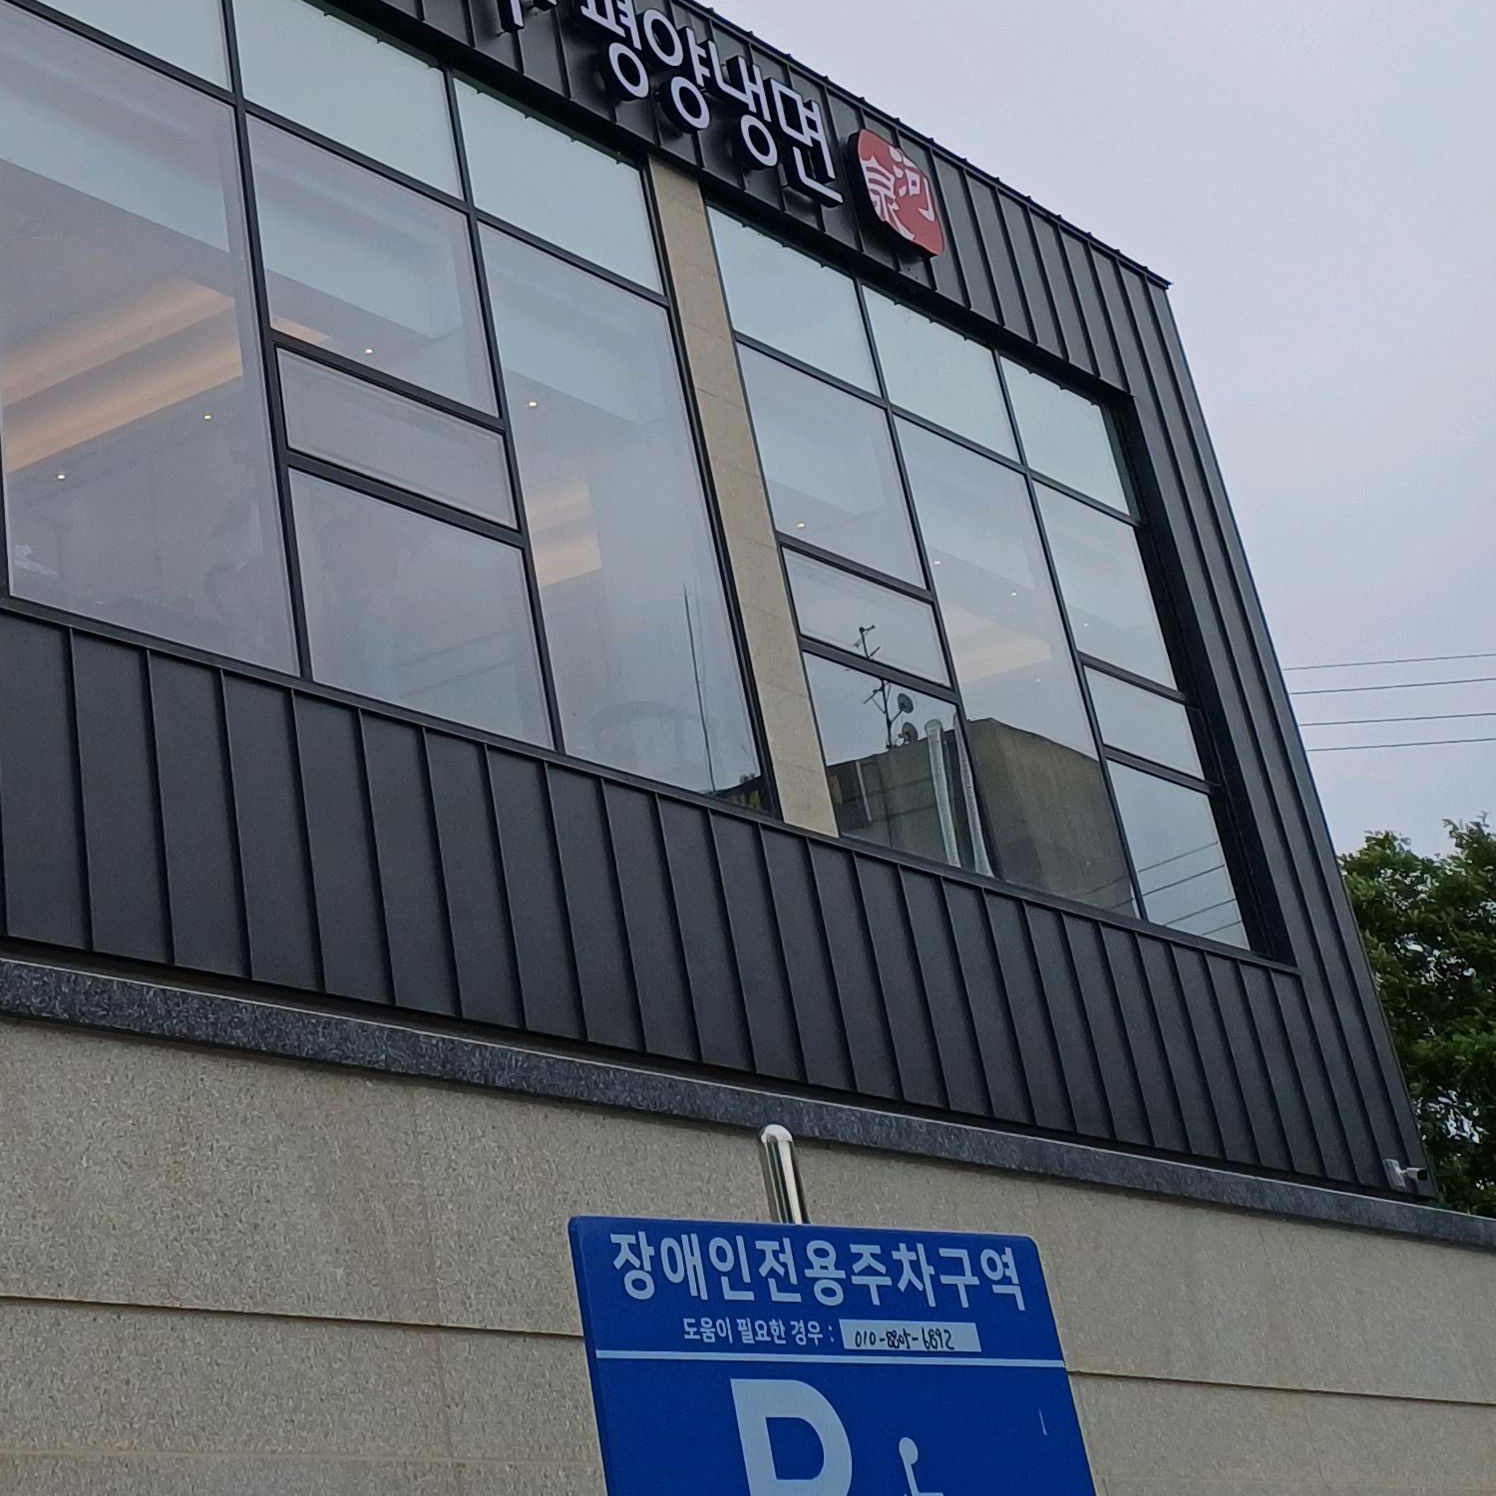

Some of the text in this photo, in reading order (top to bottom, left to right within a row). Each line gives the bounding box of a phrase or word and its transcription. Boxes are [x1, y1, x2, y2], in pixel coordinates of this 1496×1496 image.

[610, 1231, 1025, 1311] 장애인전용주차구역
[683, 1317, 733, 1344] 도움이
[736, 1318, 787, 1345] 필요한
